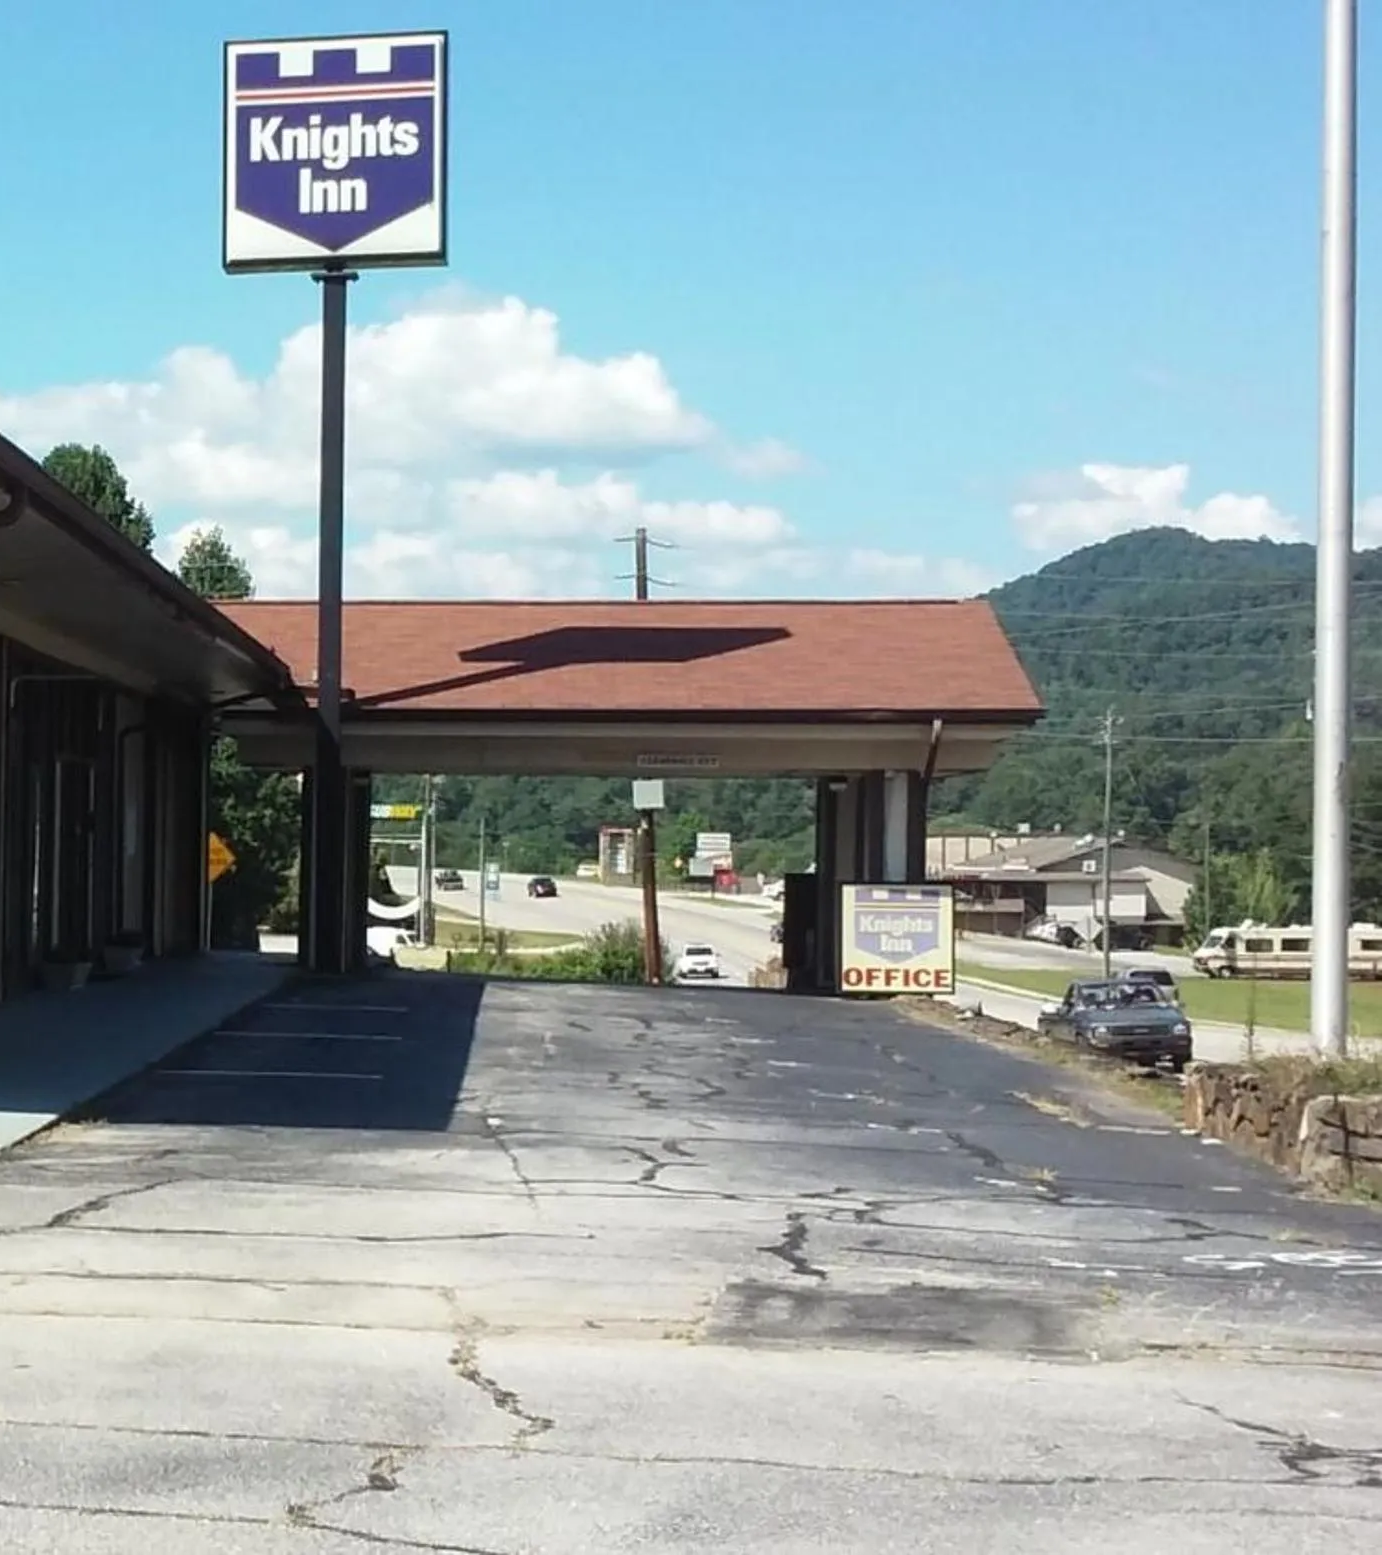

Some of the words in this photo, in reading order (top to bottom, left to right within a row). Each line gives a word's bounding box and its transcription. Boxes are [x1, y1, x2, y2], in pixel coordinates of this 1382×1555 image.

[249, 112, 420, 171] Knights
[298, 167, 367, 214] Inn
[859, 914, 933, 936] Knights
[879, 933, 913, 951] Inn
[843, 967, 950, 988] OFFICE
